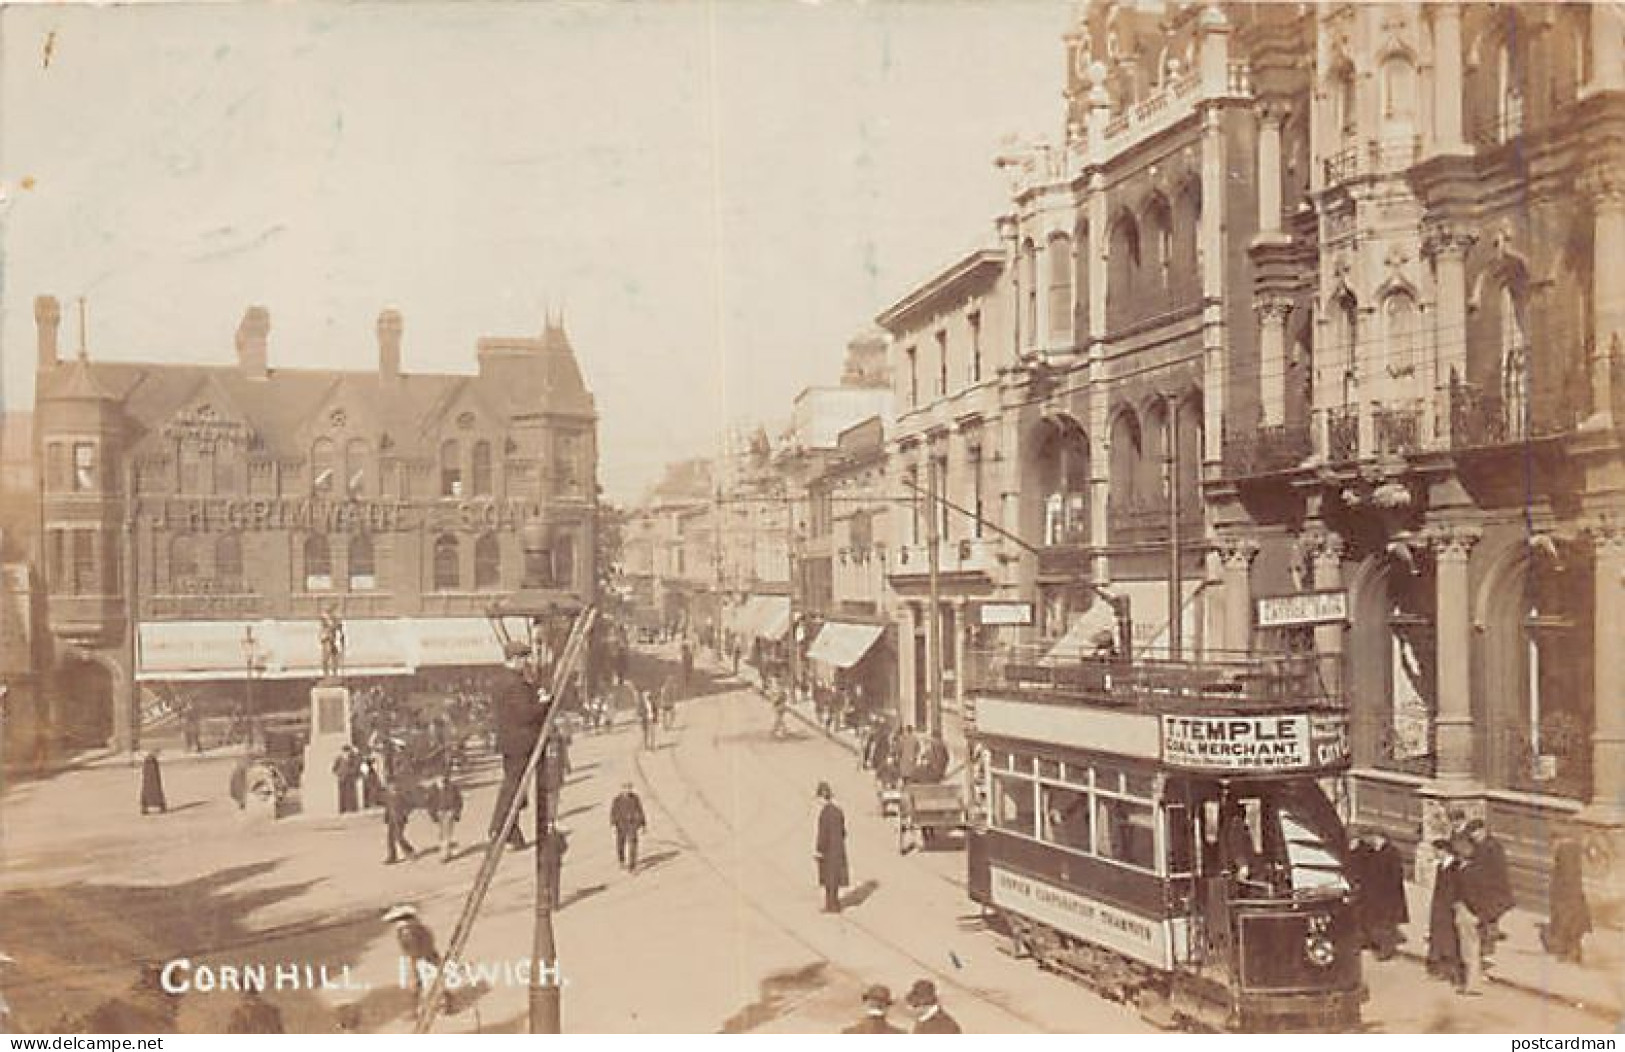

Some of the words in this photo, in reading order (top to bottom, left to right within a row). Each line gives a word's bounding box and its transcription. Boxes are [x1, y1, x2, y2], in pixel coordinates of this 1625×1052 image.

[1167, 737, 1194, 754] COAL
[1198, 741, 1298, 756] MERCHANT
[1238, 755, 1301, 765] IPSWICH
